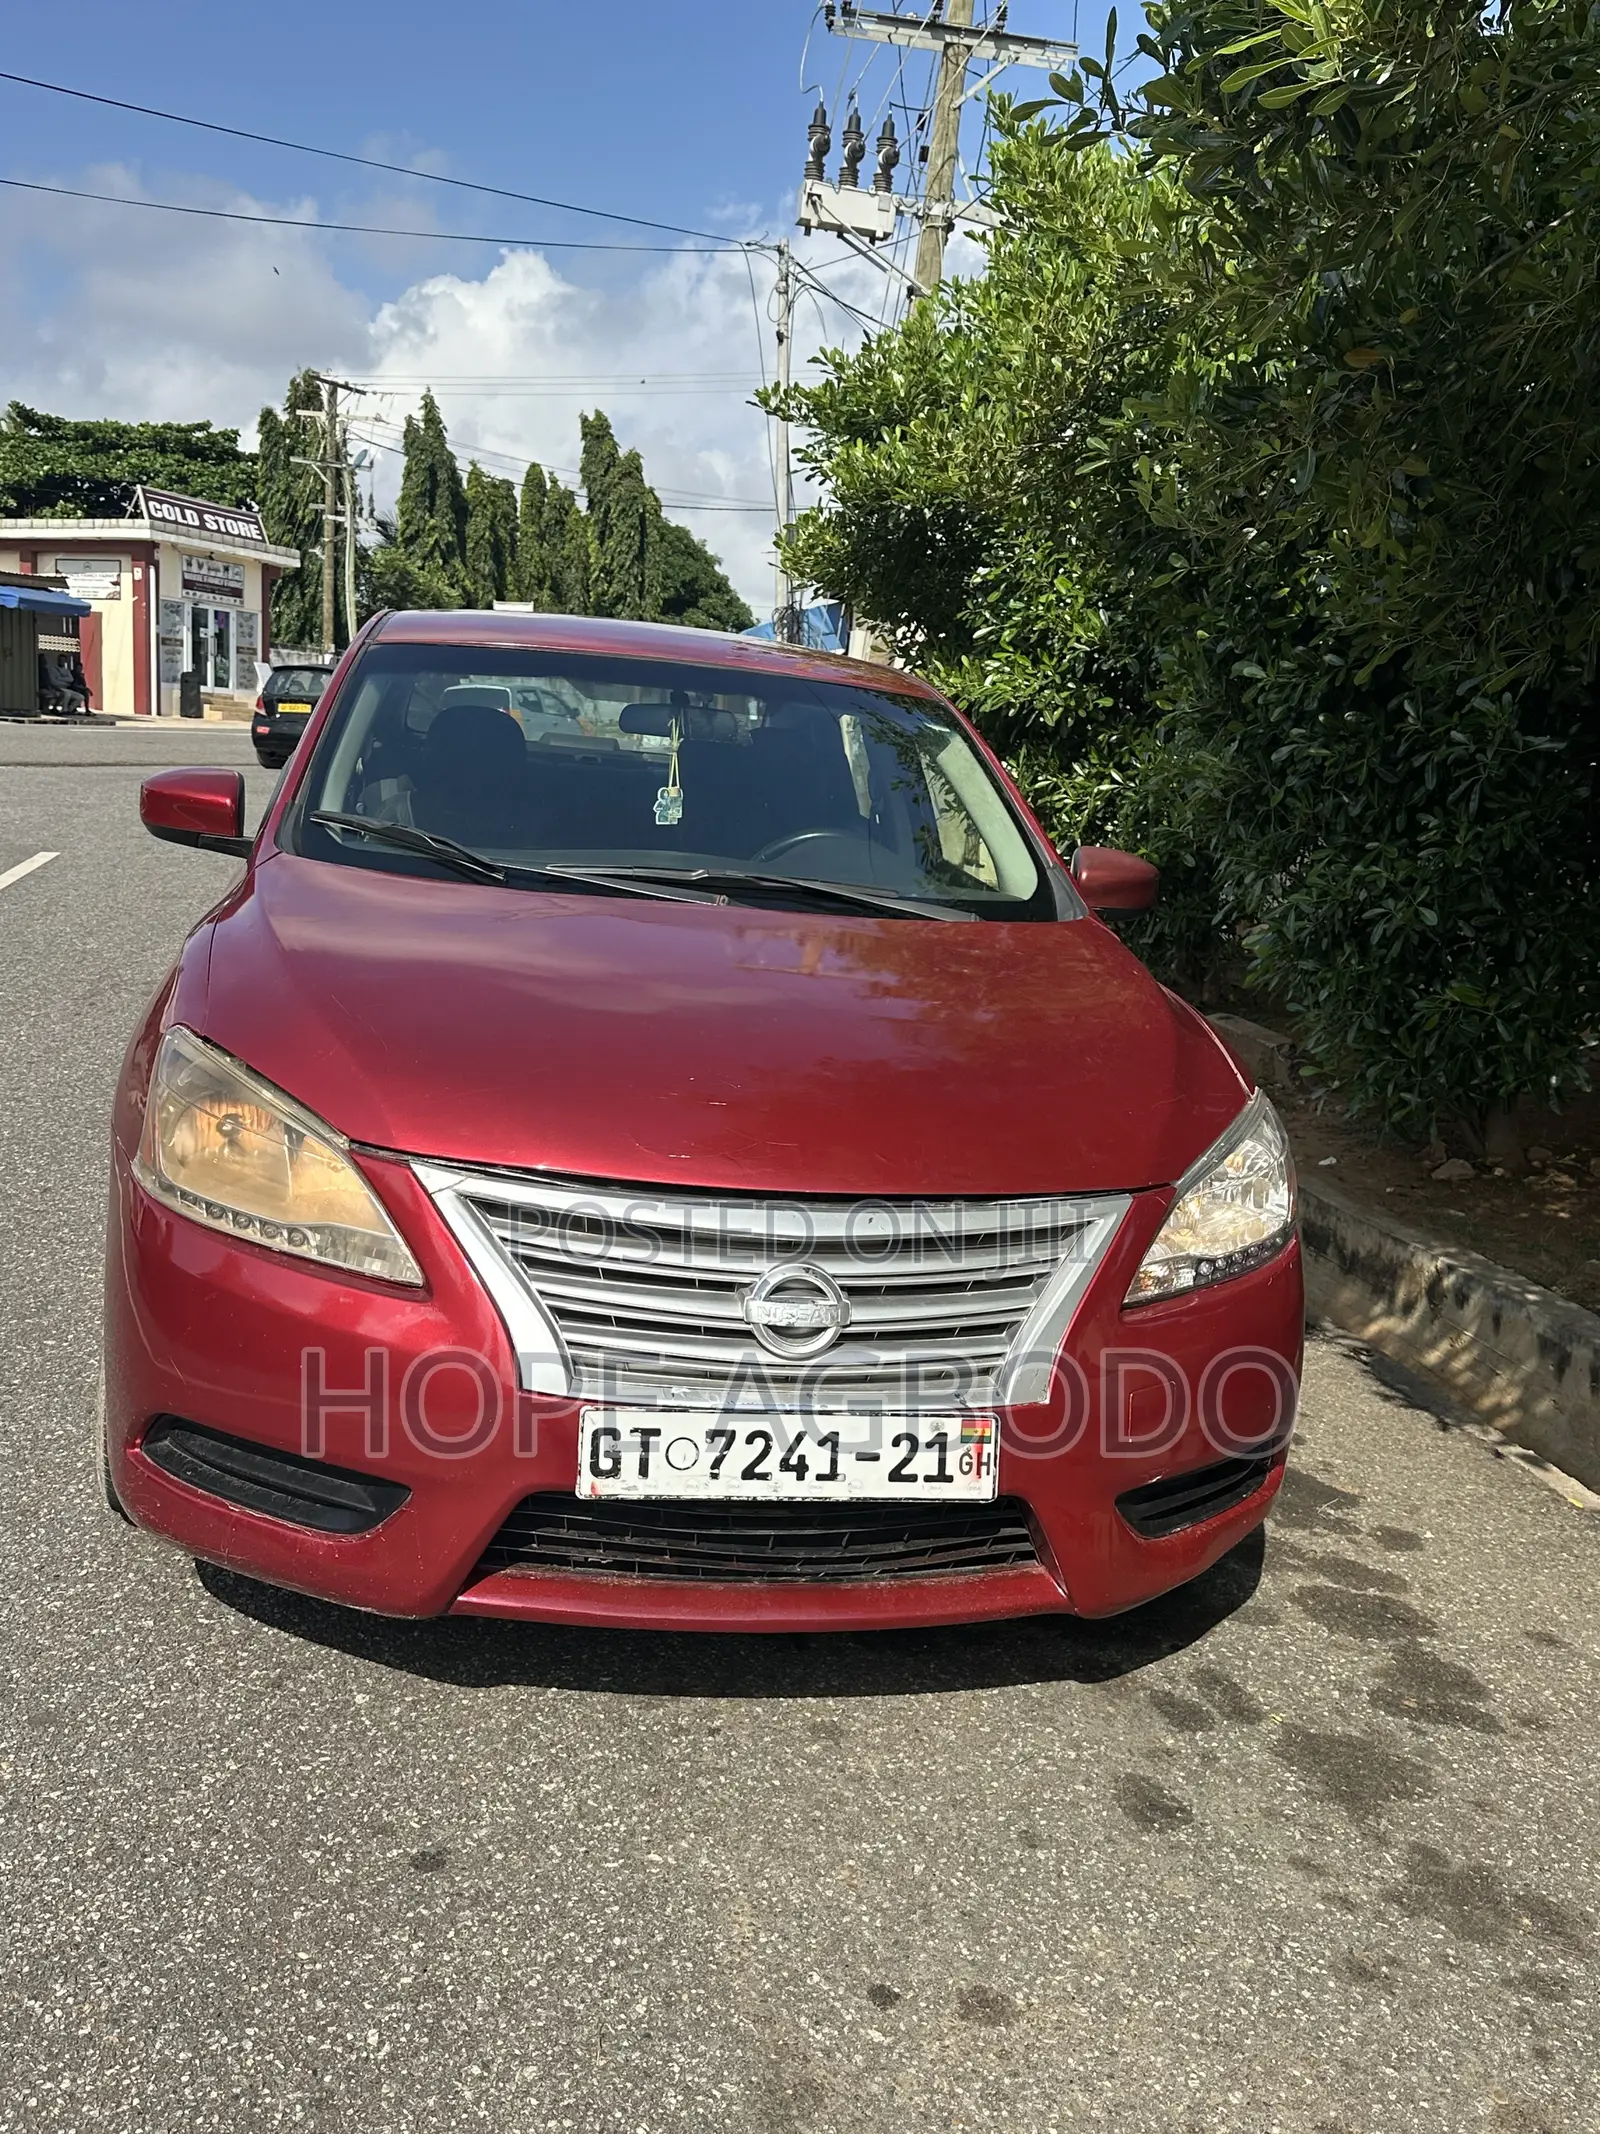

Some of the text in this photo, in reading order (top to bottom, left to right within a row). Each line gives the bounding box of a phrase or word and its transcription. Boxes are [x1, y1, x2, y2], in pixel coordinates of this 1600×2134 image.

[148, 501, 263, 540] COLD STORE
[757, 1305, 839, 1323] NISSAN
[589, 1427, 661, 1480] GT
[959, 1452, 991, 1476] GH
